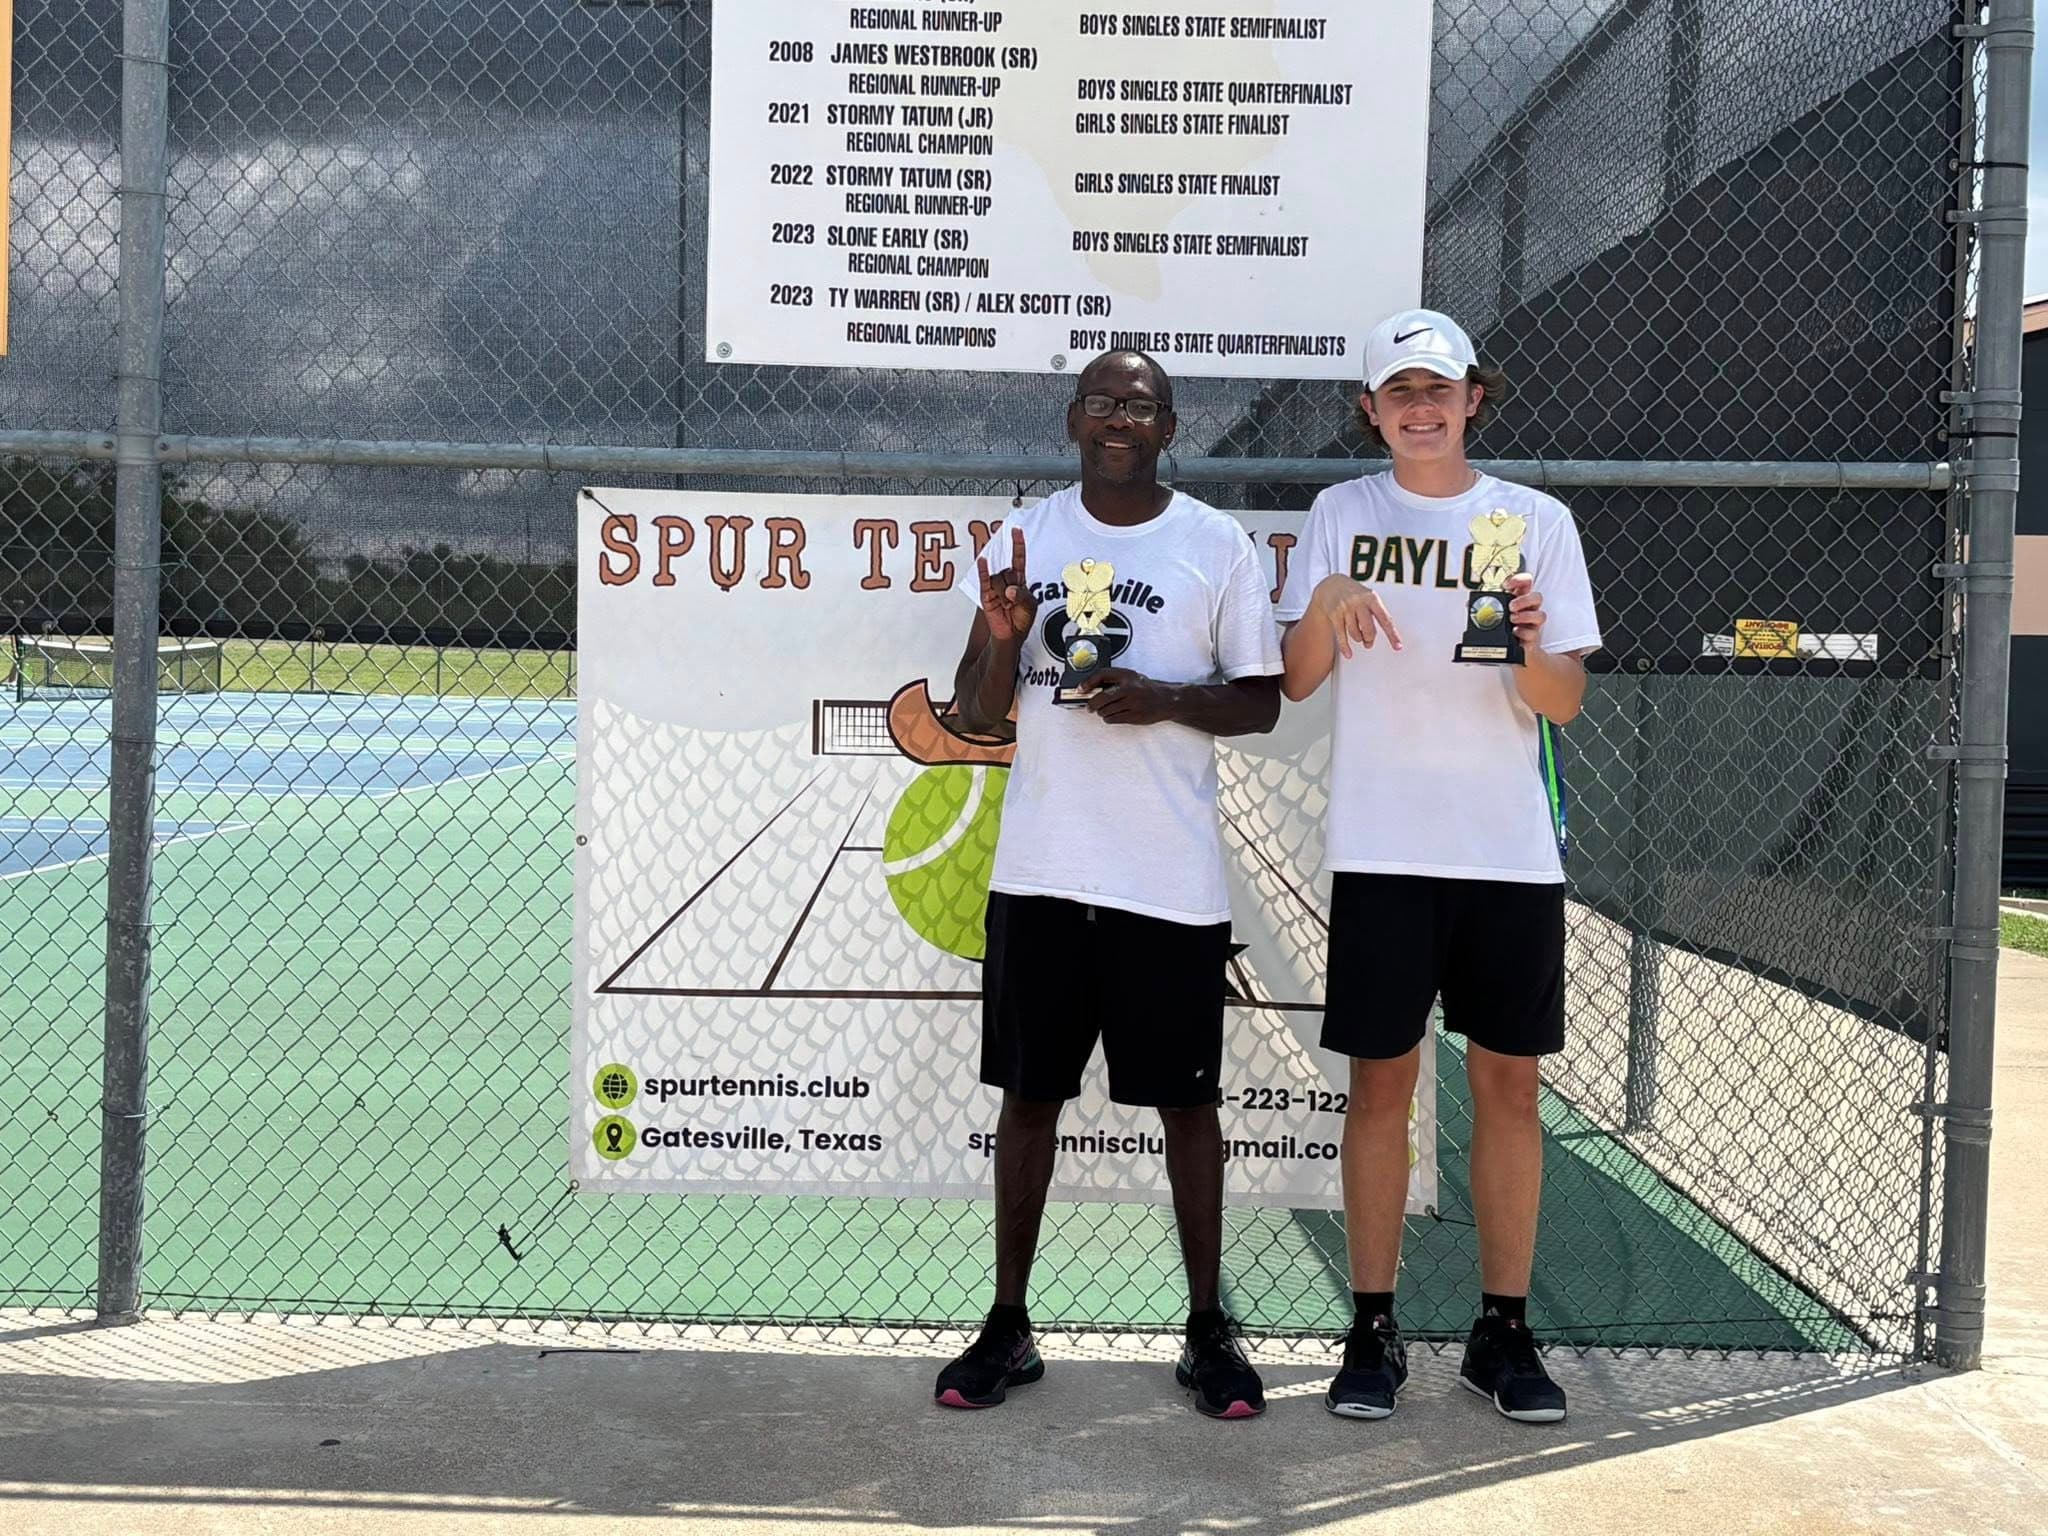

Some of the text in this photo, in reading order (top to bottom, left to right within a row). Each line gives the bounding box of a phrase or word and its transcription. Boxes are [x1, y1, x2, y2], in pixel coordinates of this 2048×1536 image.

[850, 8, 1002, 32] REGIONAL RUNNER-UP
[1080, 14, 1327, 39] BOYS SINGLES STATE SEMIFINALIST
[769, 41, 1037, 70] 2008 JAMES WESTBROOK (SR)
[849, 73, 1000, 97] REGIONAL RUNNER-UP
[1078, 79, 1353, 106] BOYS SINGLES STATE QUARTERFINALIST
[769, 102, 993, 129] 2021 STORMY TATUM (JR)
[1076, 113, 1289, 135] GIRLS SINGLES STATE FINALIST
[847, 132, 993, 155] REGIONAL CHAMPION
[771, 164, 991, 192] 2022 STORMY TATUM (SR)
[1075, 173, 1280, 196] GIRLS SINGLES STATE FINALIST
[846, 193, 992, 216] REGIONAL RUNNER-UP
[772, 223, 968, 251] 2023 SLONE EARLY (SR)
[1073, 231, 1308, 257] BOYS SINGLES STATE SEMIFINALIST
[848, 253, 989, 278] REGIONAL CHAMPION
[771, 284, 1111, 317] 2023 TY WARREN (SR) / ALEX SCOTT (SR)
[847, 322, 996, 348] REGIONAL CHAMPIONS
[1070, 330, 1346, 357] BOYS DOUBLES STATE QUARTERFINALISTS
[599, 514, 811, 591] SPUR
[1350, 534, 1526, 590] BAYLO
[645, 1073, 869, 1103] spurtennis.club
[641, 1126, 882, 1153] Gatesville, Texas
